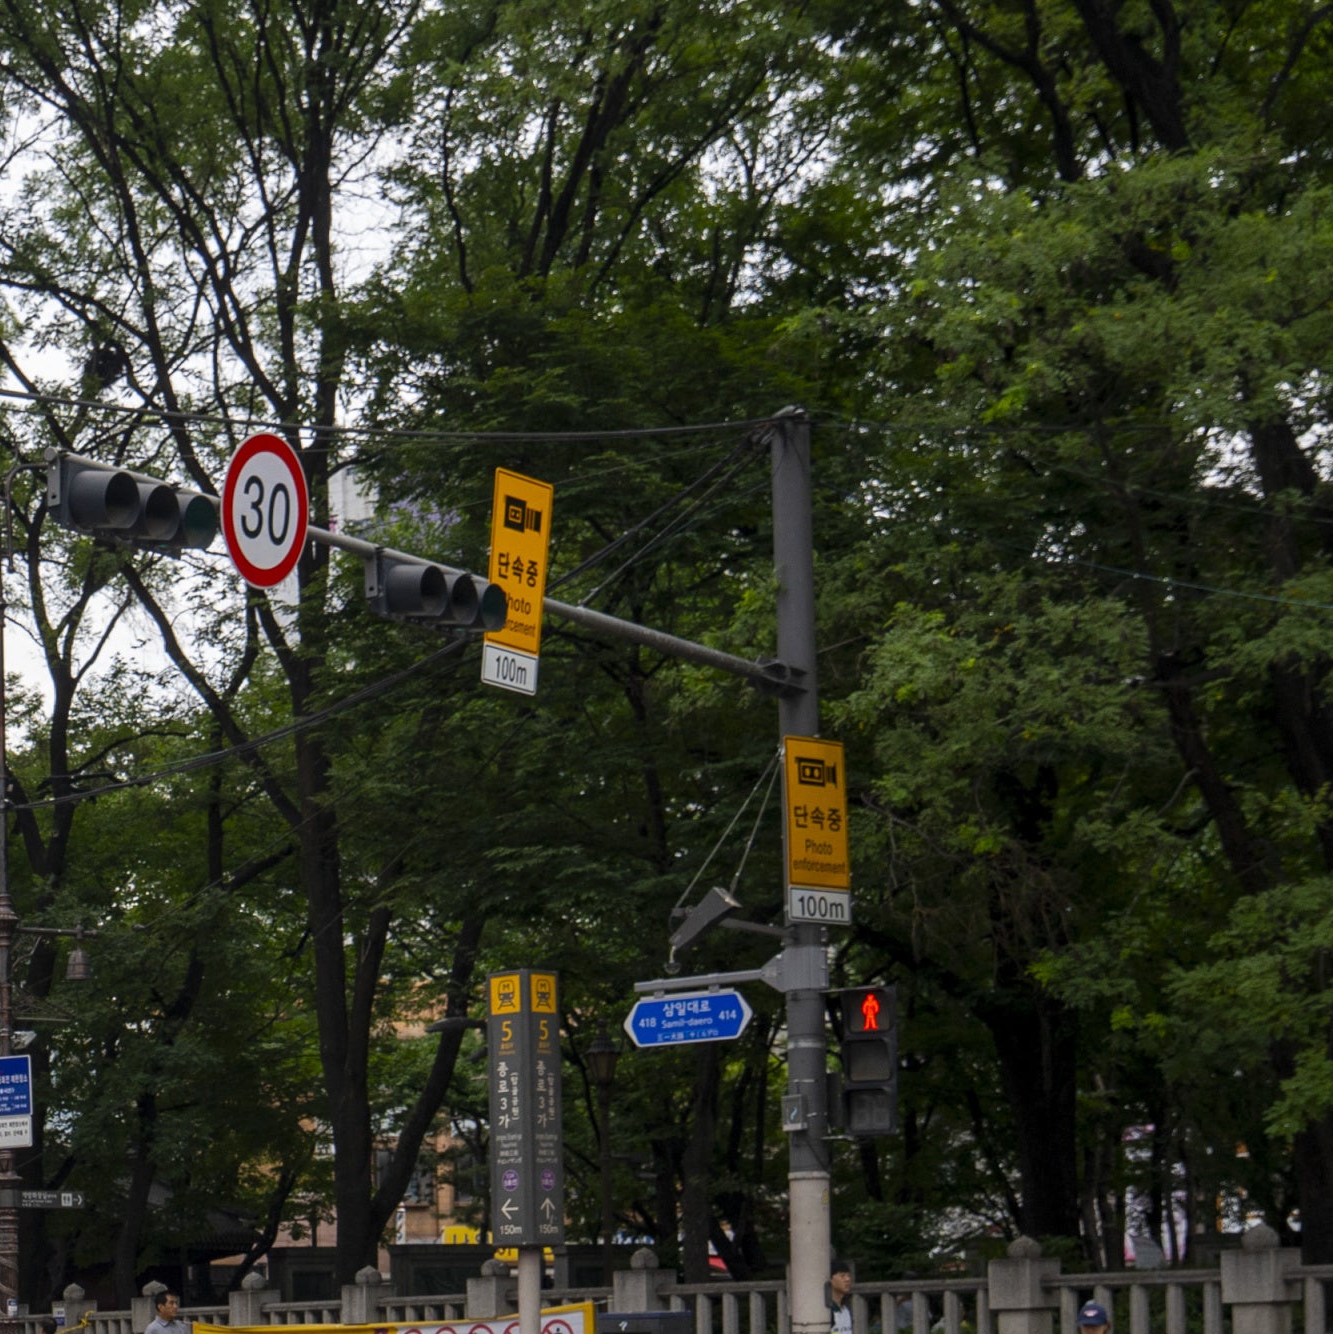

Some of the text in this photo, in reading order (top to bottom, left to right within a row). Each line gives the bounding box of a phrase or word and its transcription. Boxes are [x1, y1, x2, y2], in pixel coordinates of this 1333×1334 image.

[240, 474, 291, 547] 30
[497, 551, 539, 588] 단속중
[507, 591, 532, 616] hoto
[495, 654, 528, 685] 100m
[793, 804, 843, 833] 단속중
[804, 838, 834, 856] Photo
[792, 857, 846, 876] enforcement
[797, 895, 845, 919] 100m
[638, 1009, 737, 1029] 418 Samil-daero 414
[662, 1000, 712, 1018] 삼일대로
[501, 1020, 513, 1042] 5
[538, 1019, 549, 1041] 5
[496, 1061, 510, 1129] 종로3가
[499, 1224, 523, 1236] 150m
[538, 1224, 559, 1235] 150m
